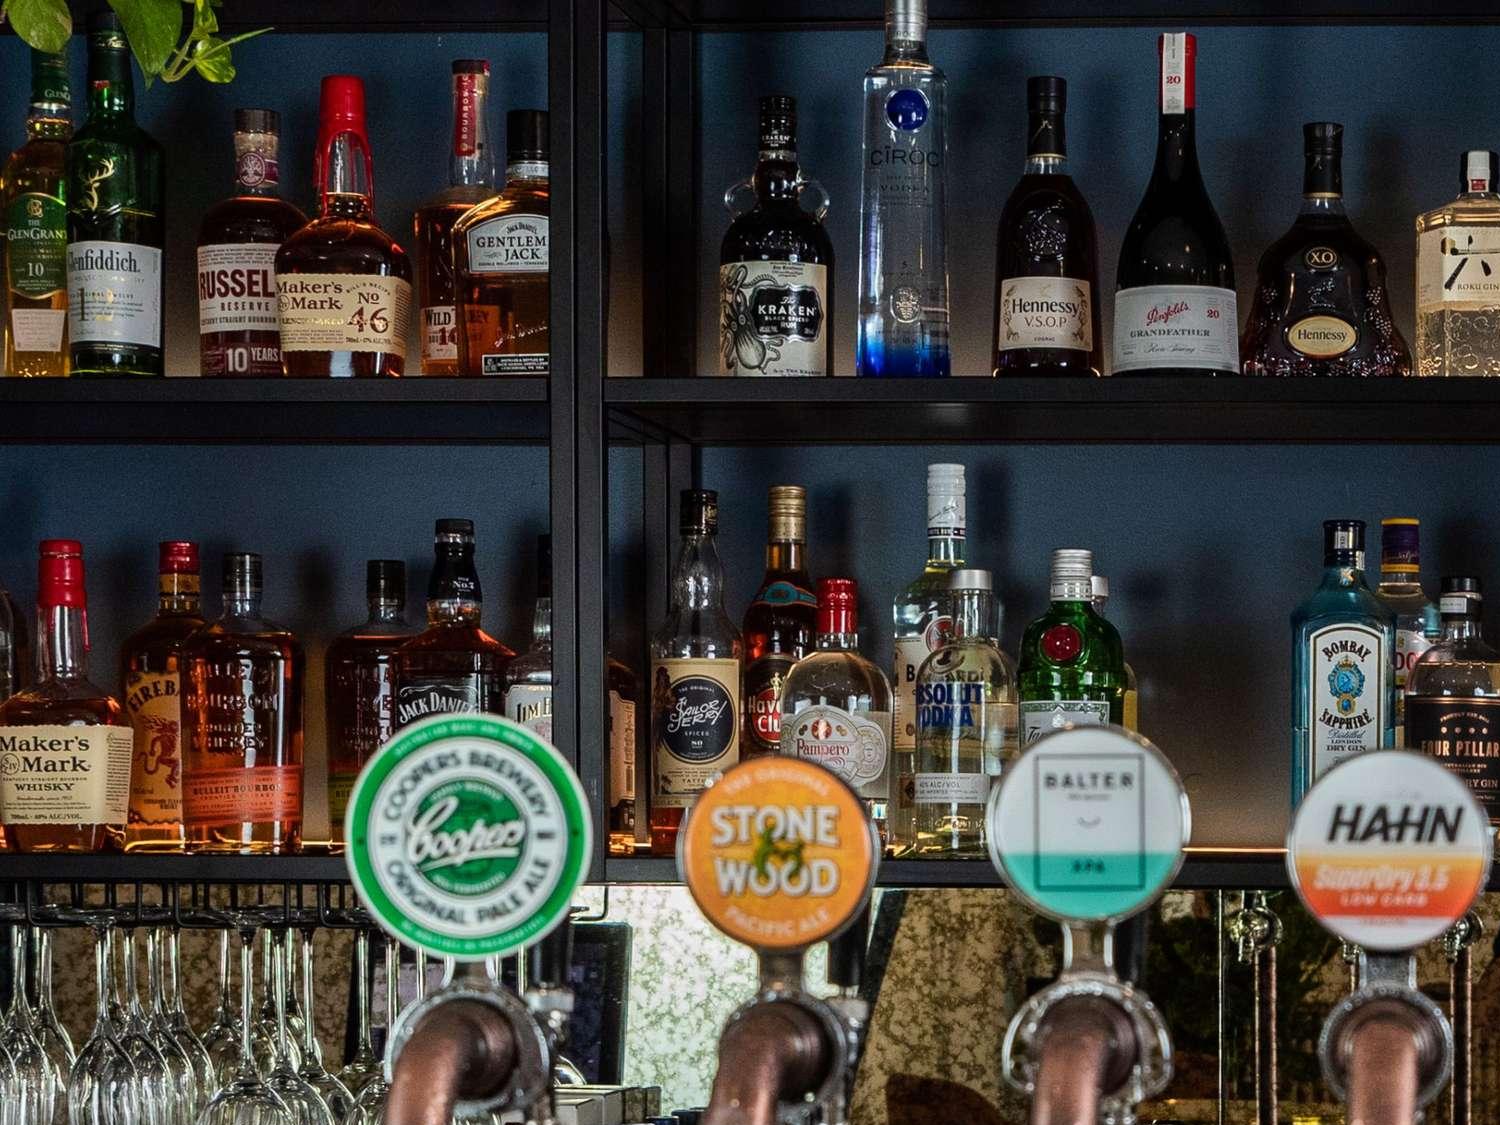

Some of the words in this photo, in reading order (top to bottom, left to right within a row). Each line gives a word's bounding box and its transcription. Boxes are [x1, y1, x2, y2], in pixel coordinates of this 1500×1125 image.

[1165, 75, 1183, 86] 20
[504, 248, 541, 262] JACK
[26, 262, 45, 277] 10
[276, 281, 343, 294] Maker's
[291, 297, 343, 310] Mark
[758, 304, 815, 316] KRAKEN
[1011, 298, 1081, 319] Hennessy
[347, 307, 389, 334] 46
[425, 309, 450, 326] WILD
[1146, 301, 1190, 326] Penfolds
[1206, 308, 1219, 319] 20
[780, 321, 797, 329] RUM
[1130, 328, 1211, 339] GRANDFATHER
[1297, 328, 1348, 344] Hennessy
[225, 347, 249, 373] 10
[251, 347, 279, 362] YEARS
[1321, 640, 1373, 662] BOMBAY
[399, 697, 428, 724] JACK
[1320, 708, 1375, 730] SAPPHIRE
[0, 736, 91, 752] Maker's
[796, 737, 850, 758] Pampero
[1326, 744, 1345, 752] DRY
[1347, 744, 1367, 752] GIN
[21, 756, 92, 773] Mark
[15, 783, 75, 791] WHISKY
[1480, 778, 1498, 789] GIN
[710, 804, 841, 849] STONE
[1327, 803, 1465, 843] HAHN
[713, 856, 839, 897] WOOD
